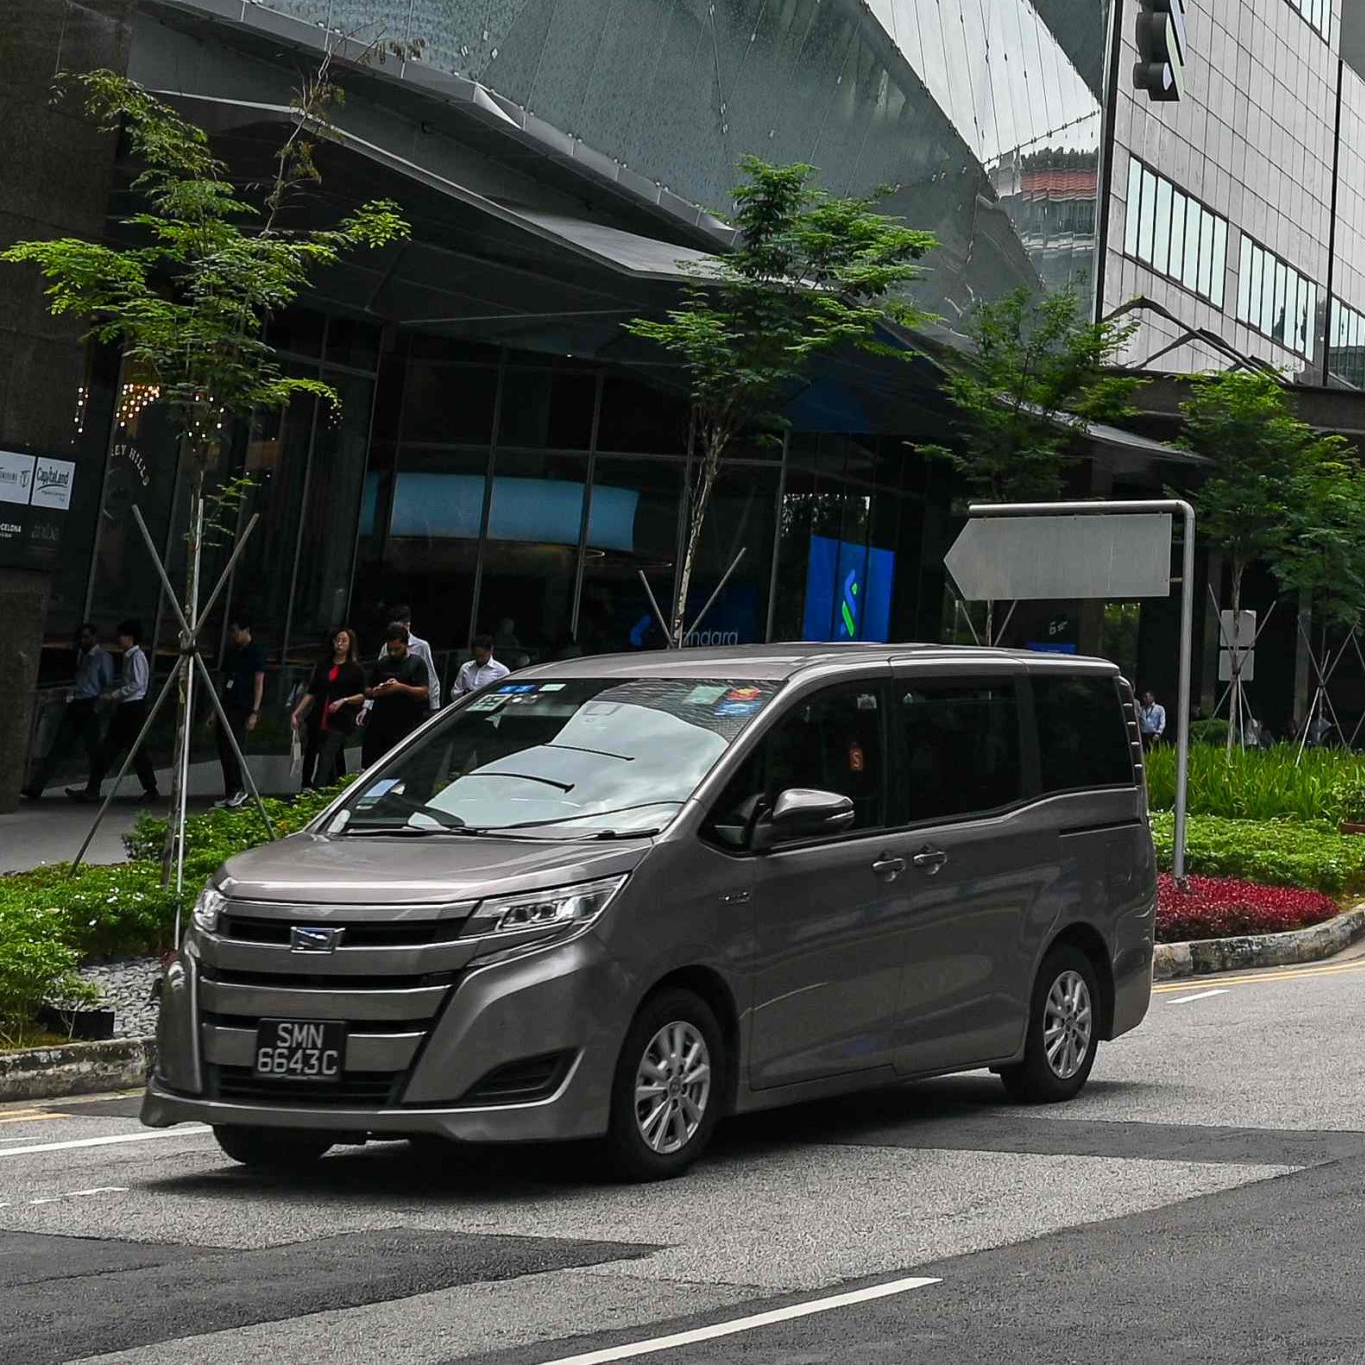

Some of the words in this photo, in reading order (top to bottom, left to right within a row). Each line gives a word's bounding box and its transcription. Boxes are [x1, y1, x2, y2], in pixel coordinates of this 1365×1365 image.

[0, 522, 21, 533] CELONA
[277, 1023, 324, 1048] SMN
[257, 1047, 338, 1075] 6643C
